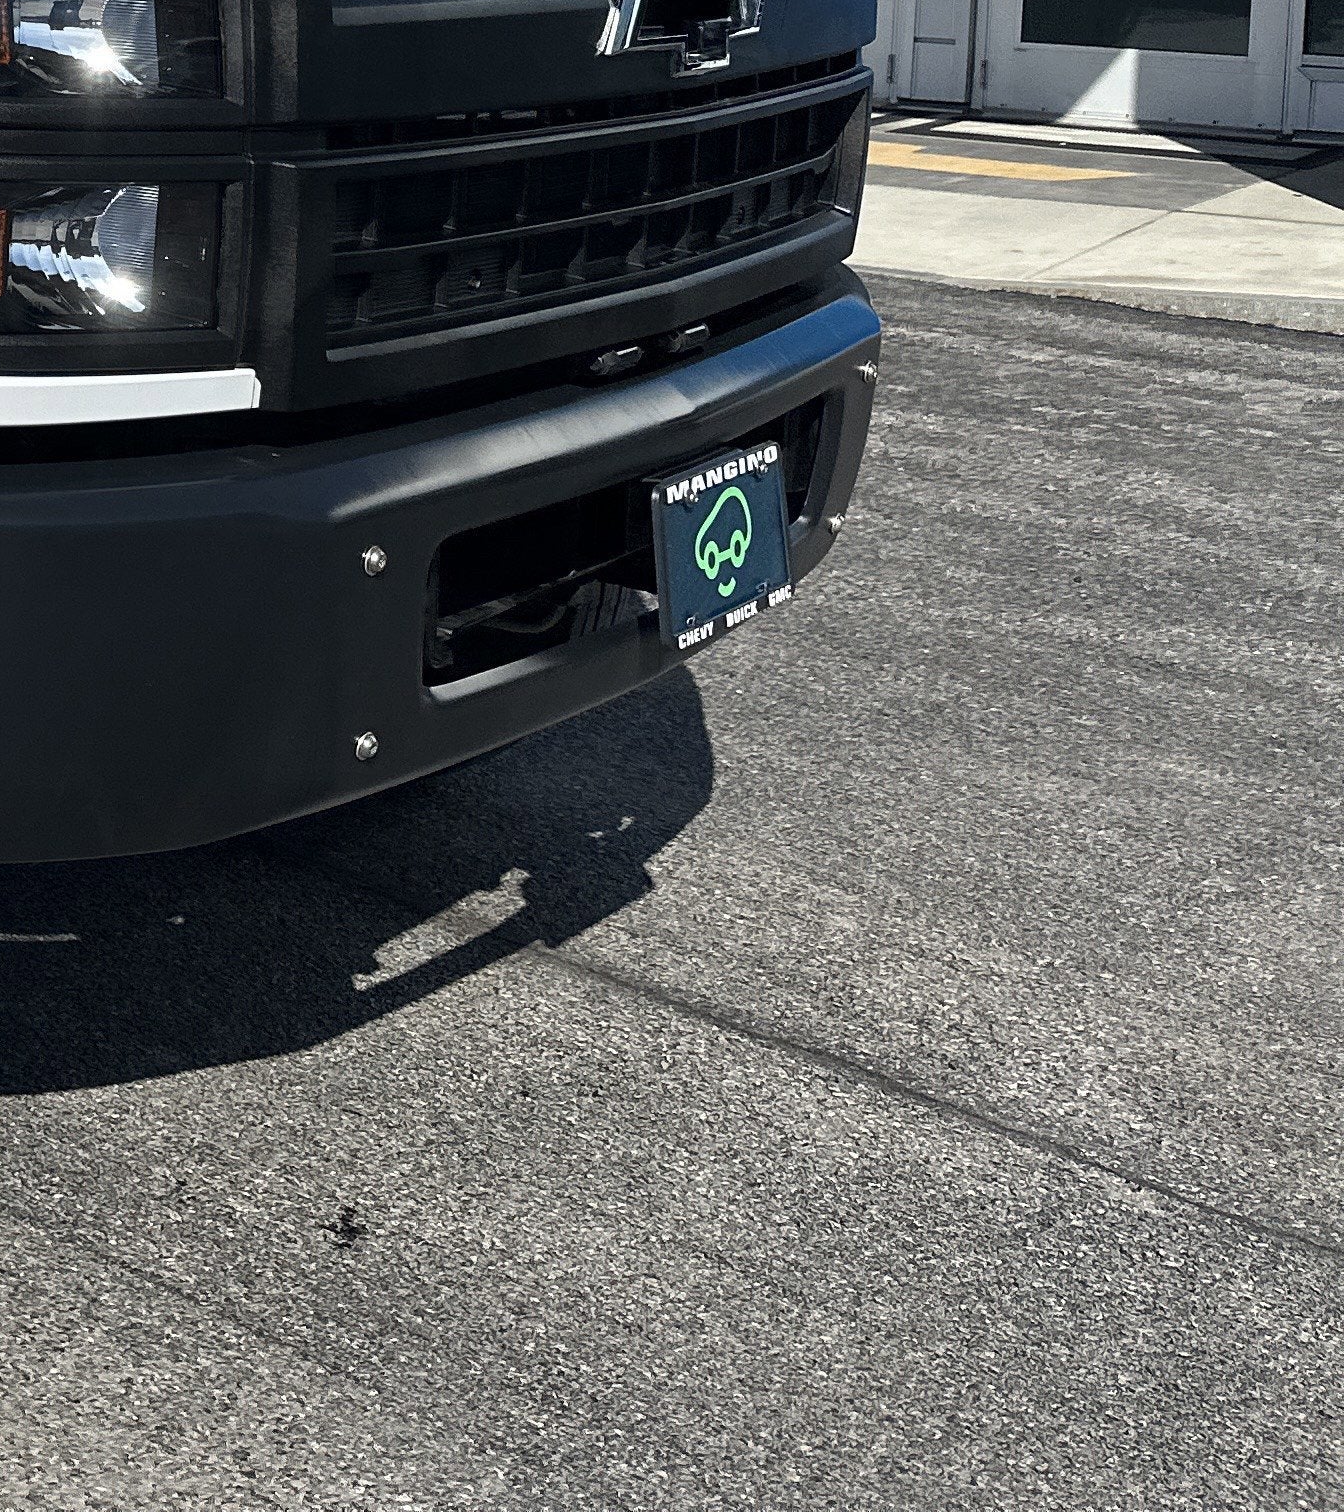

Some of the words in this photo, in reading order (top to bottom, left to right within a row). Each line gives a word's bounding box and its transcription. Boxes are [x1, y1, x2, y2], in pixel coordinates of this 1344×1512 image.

[666, 444, 779, 504] MANGINO
[678, 621, 714, 650] CHEVY
[726, 600, 759, 628] BUICK
[767, 584, 793, 608] GMC
